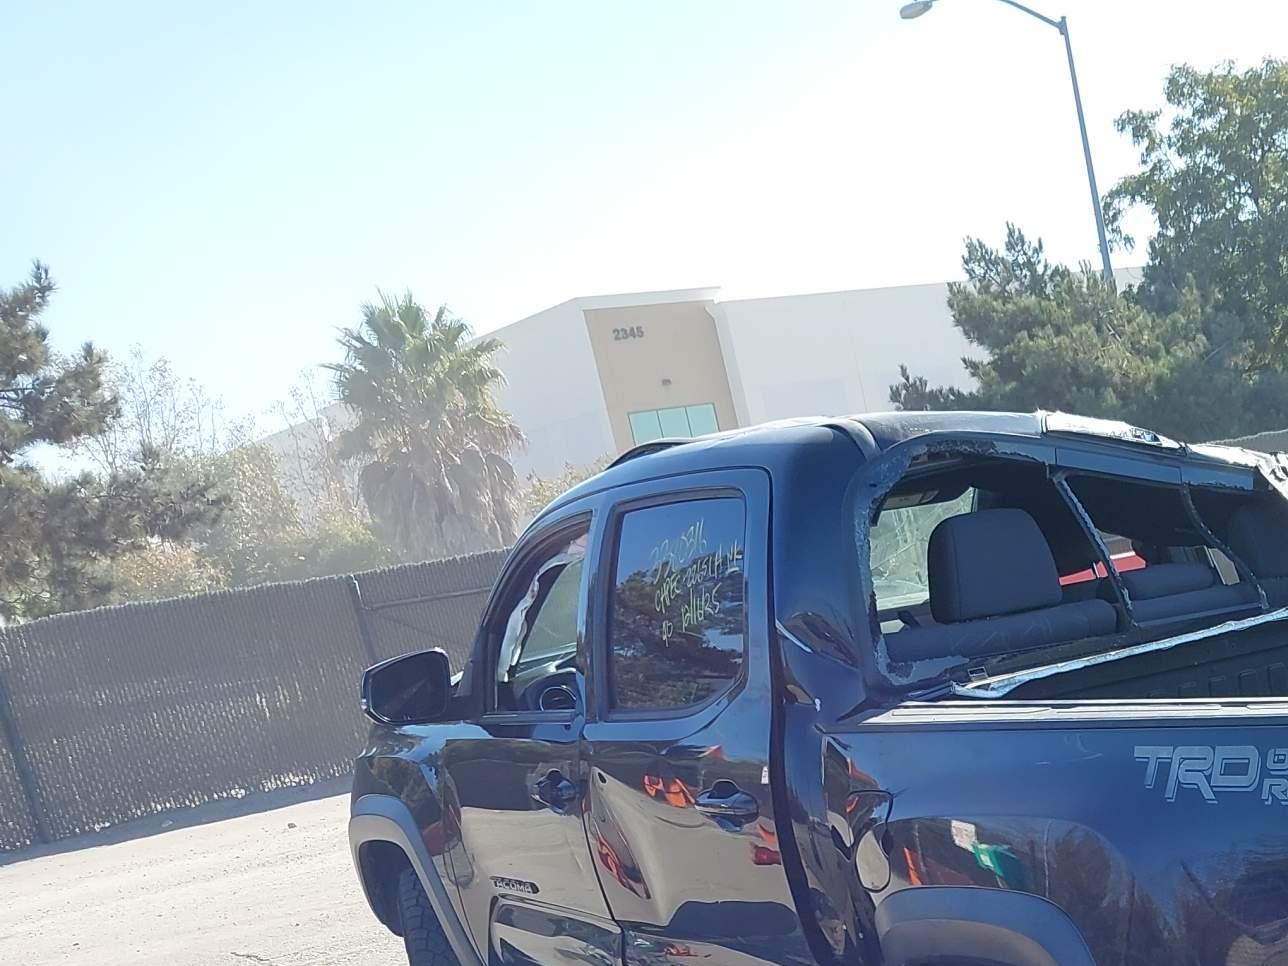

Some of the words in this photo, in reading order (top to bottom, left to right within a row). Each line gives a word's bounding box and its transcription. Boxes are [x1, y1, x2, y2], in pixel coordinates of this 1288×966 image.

[612, 325, 645, 342] 2345
[1133, 745, 1261, 803] TRD
[488, 876, 534, 894] TACOMA
